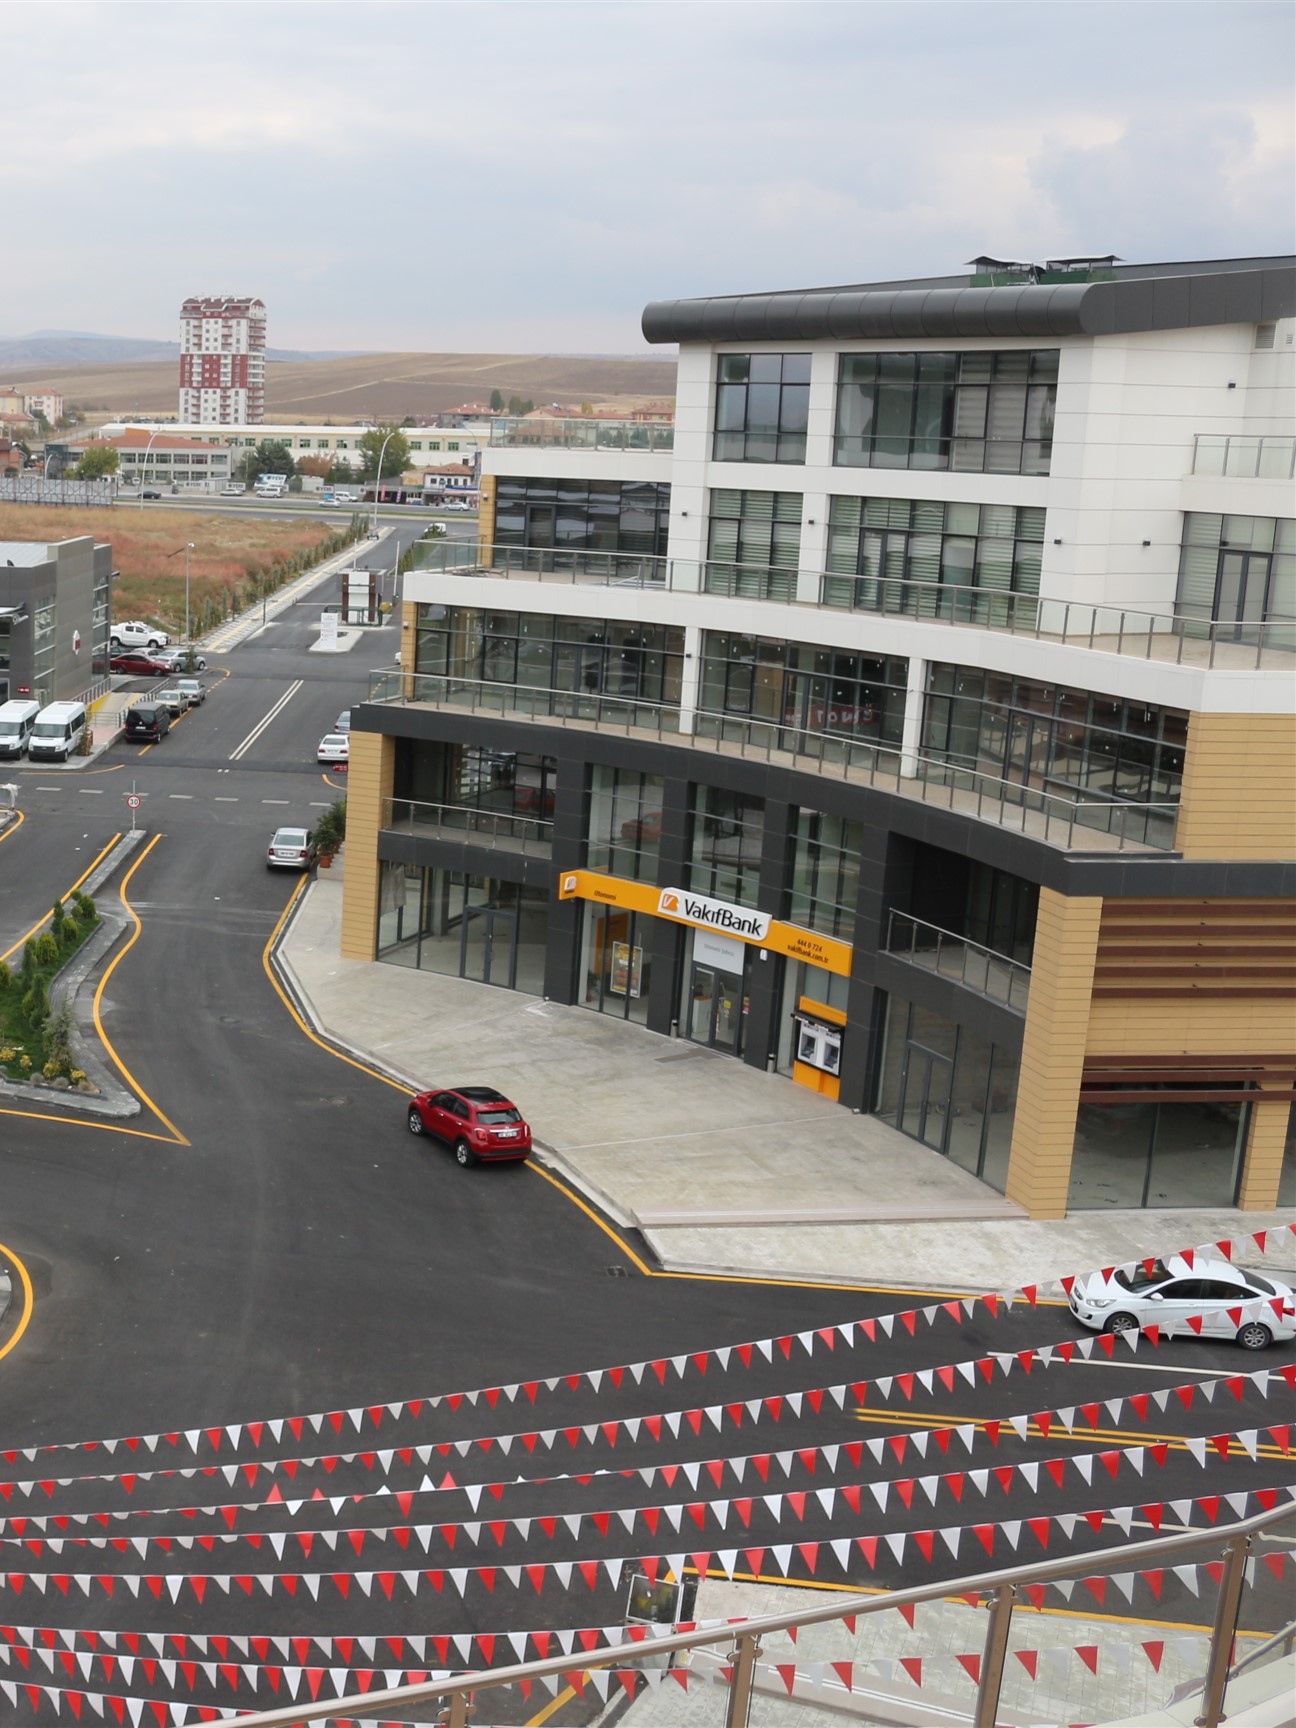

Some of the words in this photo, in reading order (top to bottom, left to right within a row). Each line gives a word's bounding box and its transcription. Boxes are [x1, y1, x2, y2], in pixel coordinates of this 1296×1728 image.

[685, 899, 762, 936] VakıfBank
[797, 939, 807, 947] 444
[813, 944, 823, 953] 724
